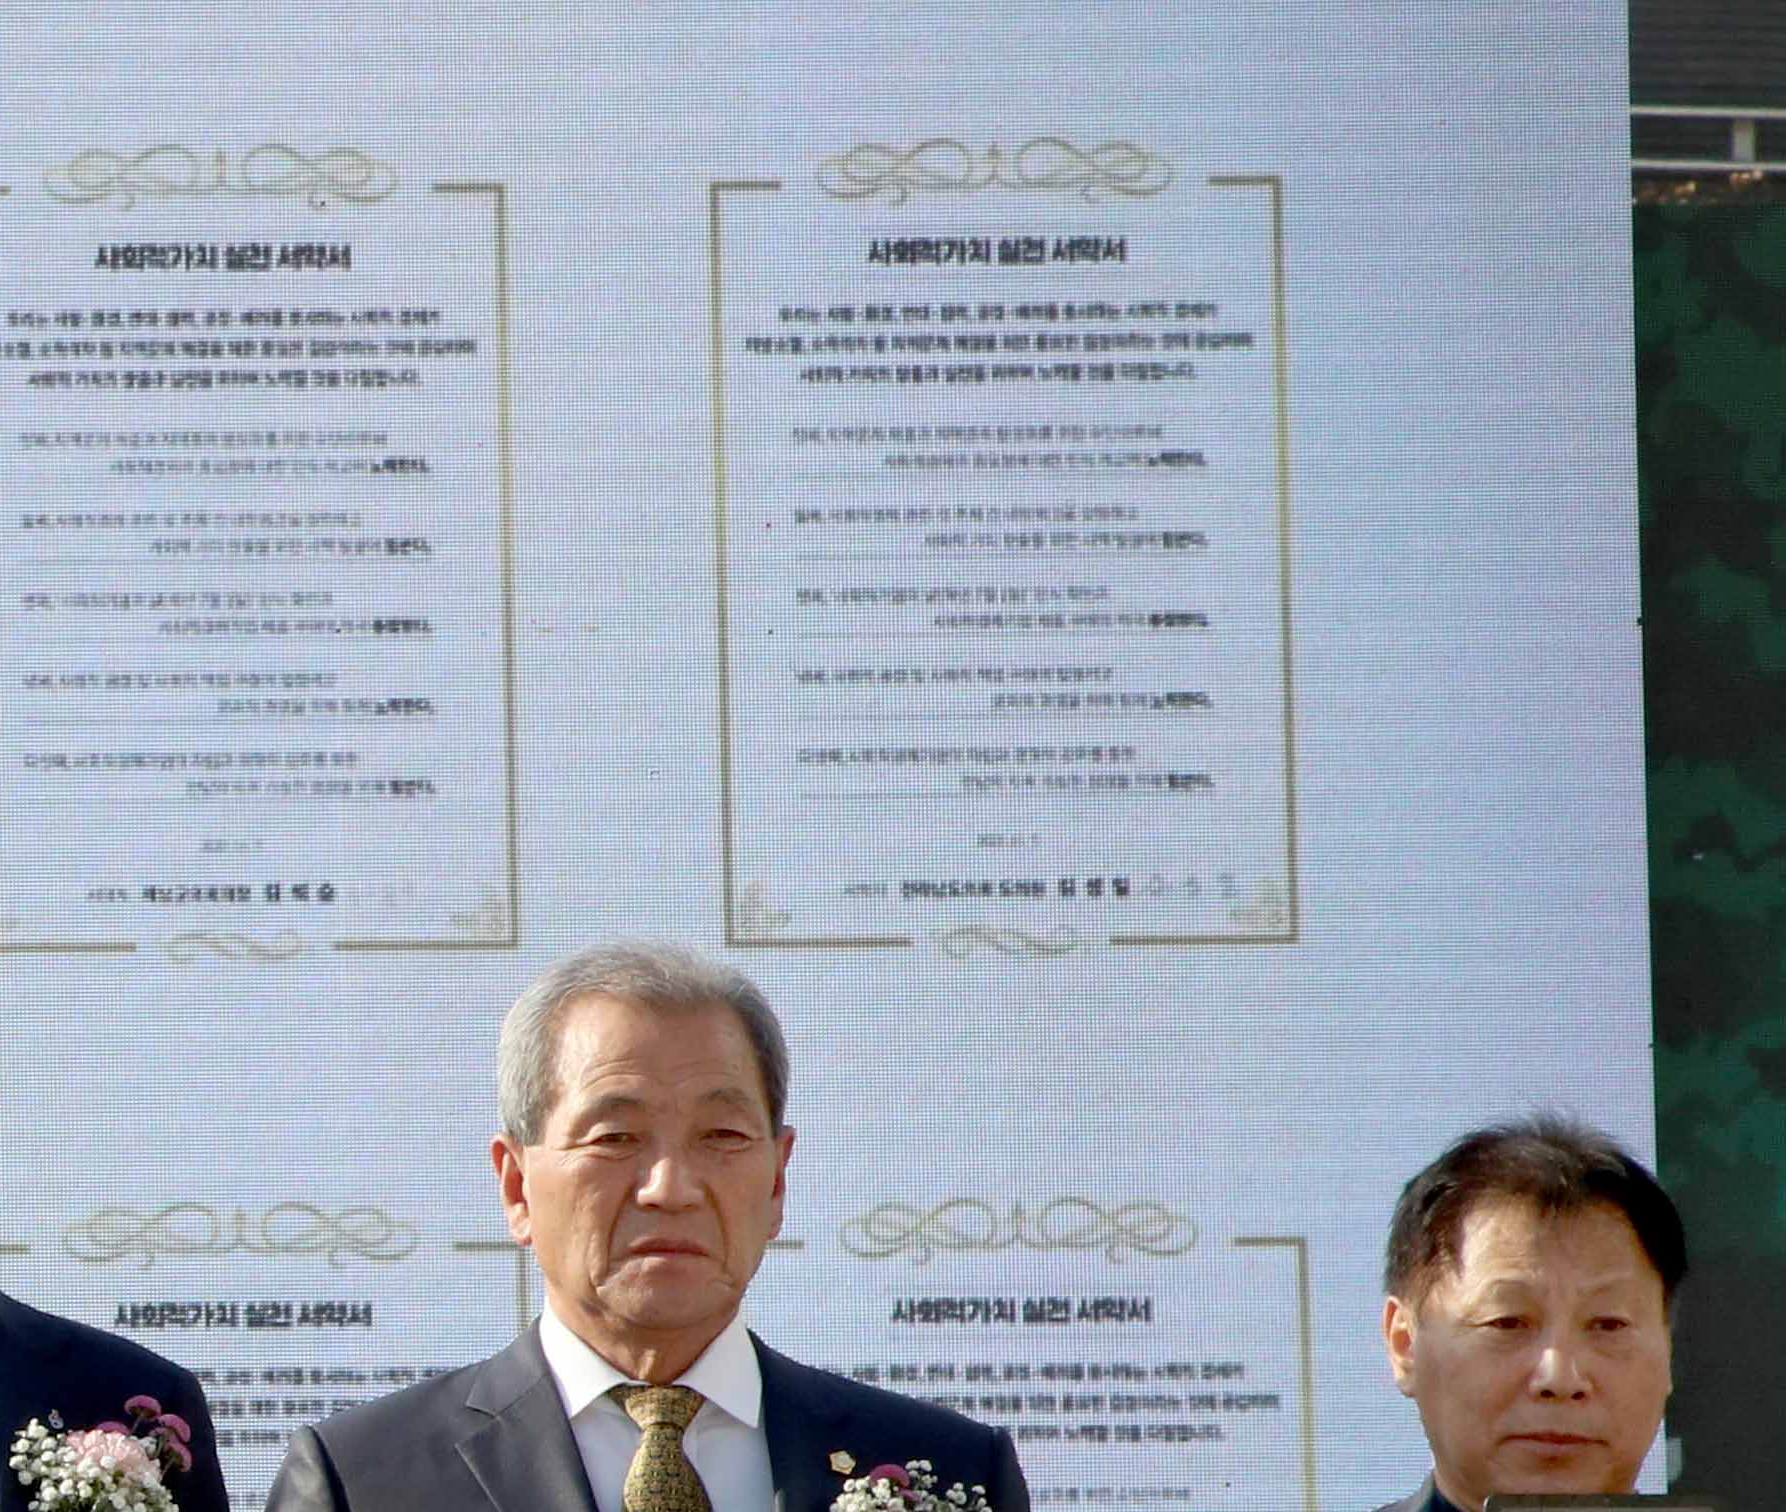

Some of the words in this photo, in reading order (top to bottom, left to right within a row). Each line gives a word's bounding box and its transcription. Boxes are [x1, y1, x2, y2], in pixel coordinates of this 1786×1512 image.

[93, 242, 218, 270] 사회적가치
[225, 242, 271, 270] 실천
[277, 243, 351, 270] 서약서
[866, 237, 992, 265] 사회적가치
[999, 236, 1045, 264] 실천
[1051, 236, 1126, 264] 서약서
[114, 1301, 237, 1329] 사회적가치
[244, 1301, 291, 1329] 실천
[297, 1301, 372, 1329] 서약서
[891, 1296, 1015, 1324] 사회적가치
[1023, 1296, 1070, 1324] 실천
[1076, 1296, 1152, 1324] 서약서
